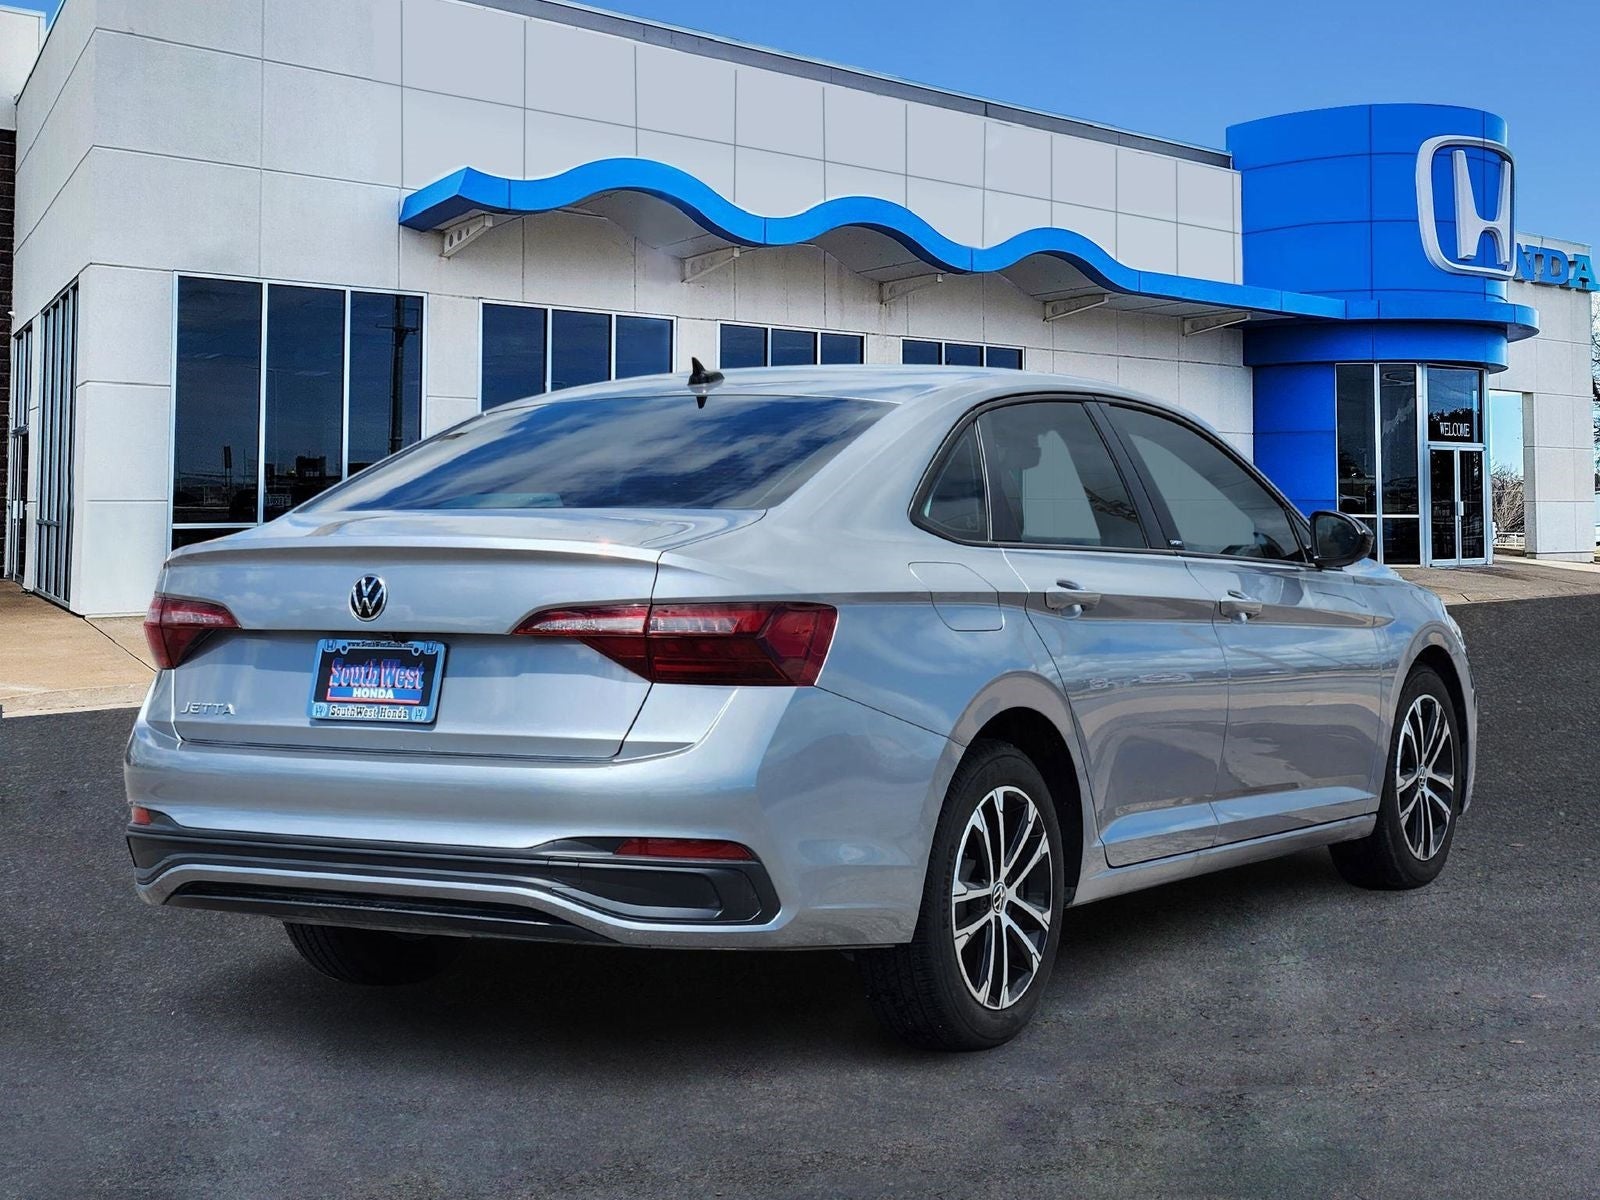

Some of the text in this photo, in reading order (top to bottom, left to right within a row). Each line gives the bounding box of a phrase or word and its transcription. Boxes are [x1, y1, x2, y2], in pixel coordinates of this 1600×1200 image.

[1439, 422, 1471, 437] WELCOME
[353, 688, 394, 699] HONDA
[180, 702, 235, 716] JETTA
[330, 705, 408, 719] SouthWest Honda
